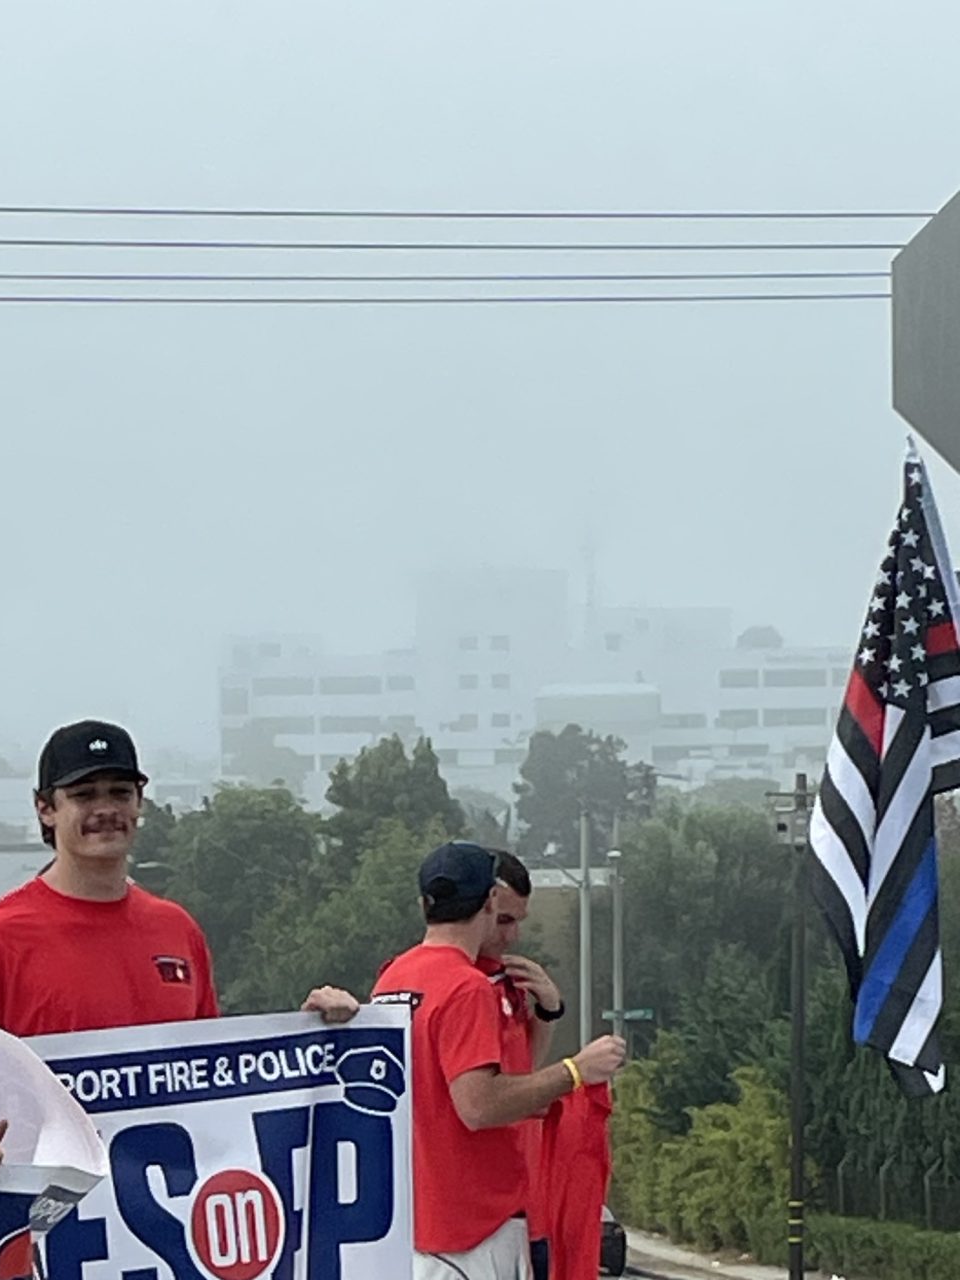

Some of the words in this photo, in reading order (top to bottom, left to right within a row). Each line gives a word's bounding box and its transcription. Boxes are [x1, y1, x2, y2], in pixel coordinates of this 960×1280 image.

[54, 1066, 142, 1102] PORT
[147, 1058, 209, 1095] FIRE
[212, 1056, 236, 1088] &
[239, 1043, 336, 1084] POLICE
[205, 1188, 270, 1269] on
